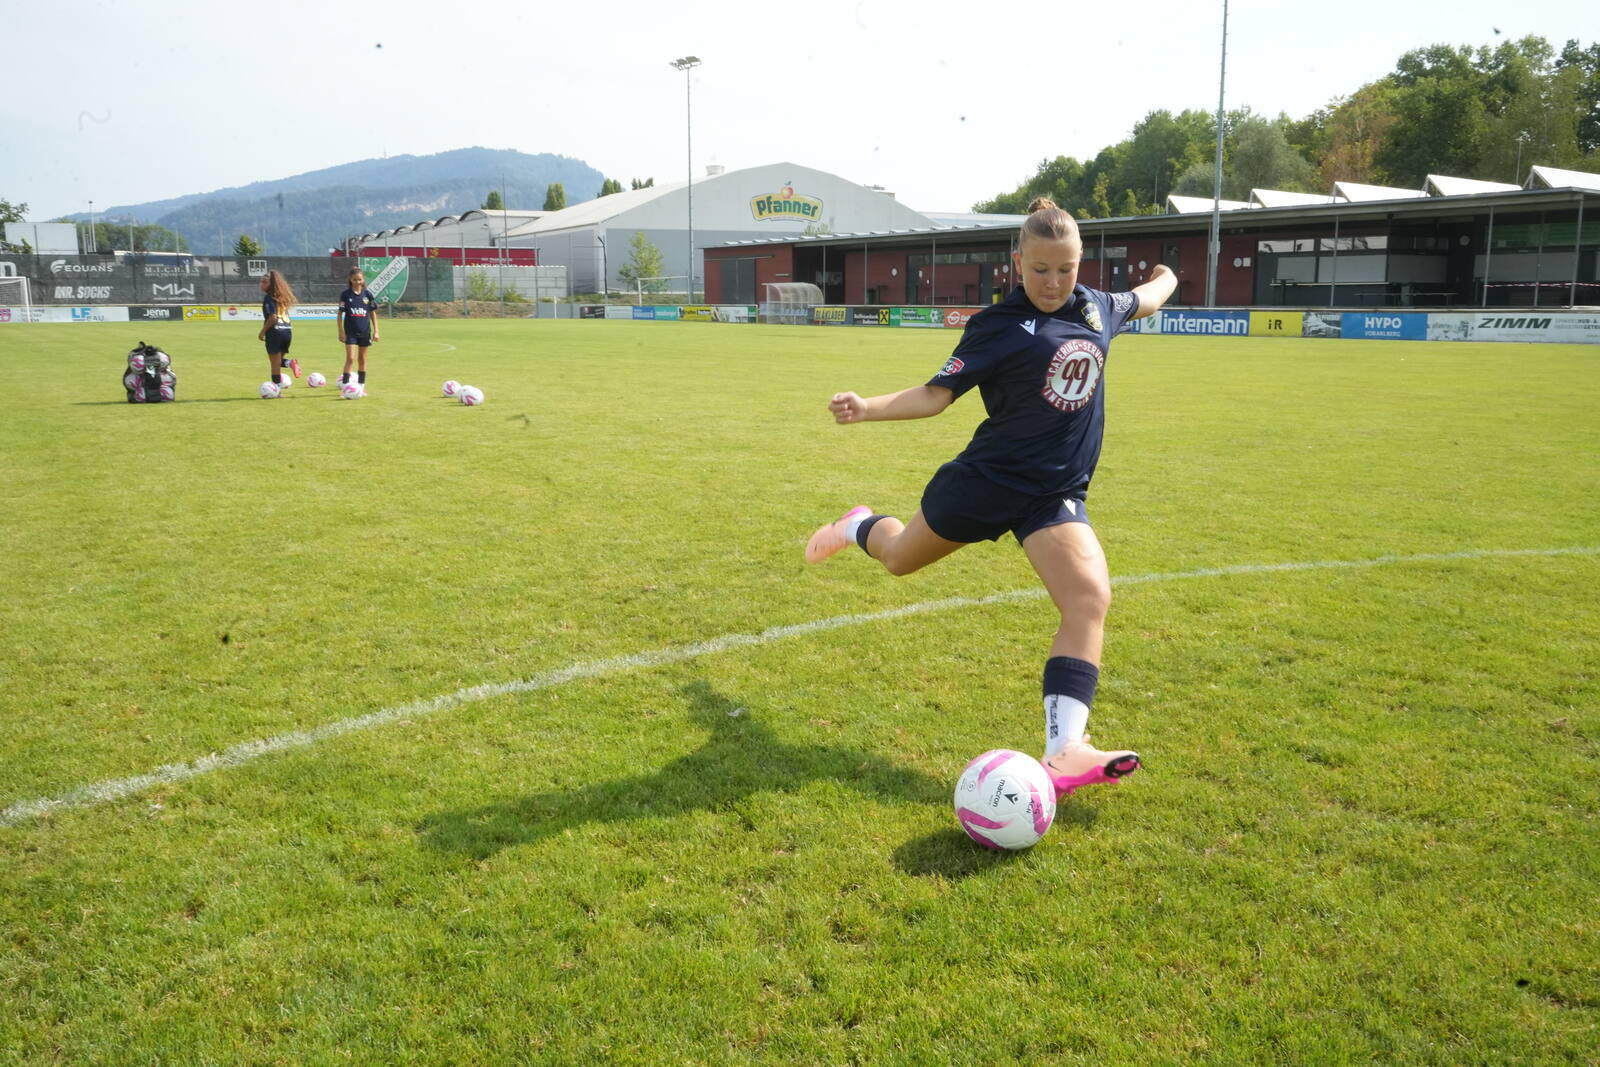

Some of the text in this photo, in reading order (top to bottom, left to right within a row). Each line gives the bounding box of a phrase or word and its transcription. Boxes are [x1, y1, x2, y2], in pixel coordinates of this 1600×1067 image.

[364, 257, 380, 272] FC
[77, 286, 111, 299] SOCKS
[71, 307, 91, 318] LF
[1162, 313, 1248, 334] intemann
[1364, 316, 1402, 329] HYPO
[1478, 317, 1553, 329] ZIMM
[1061, 358, 1091, 394] 99
[992, 778, 1006, 808] macron
